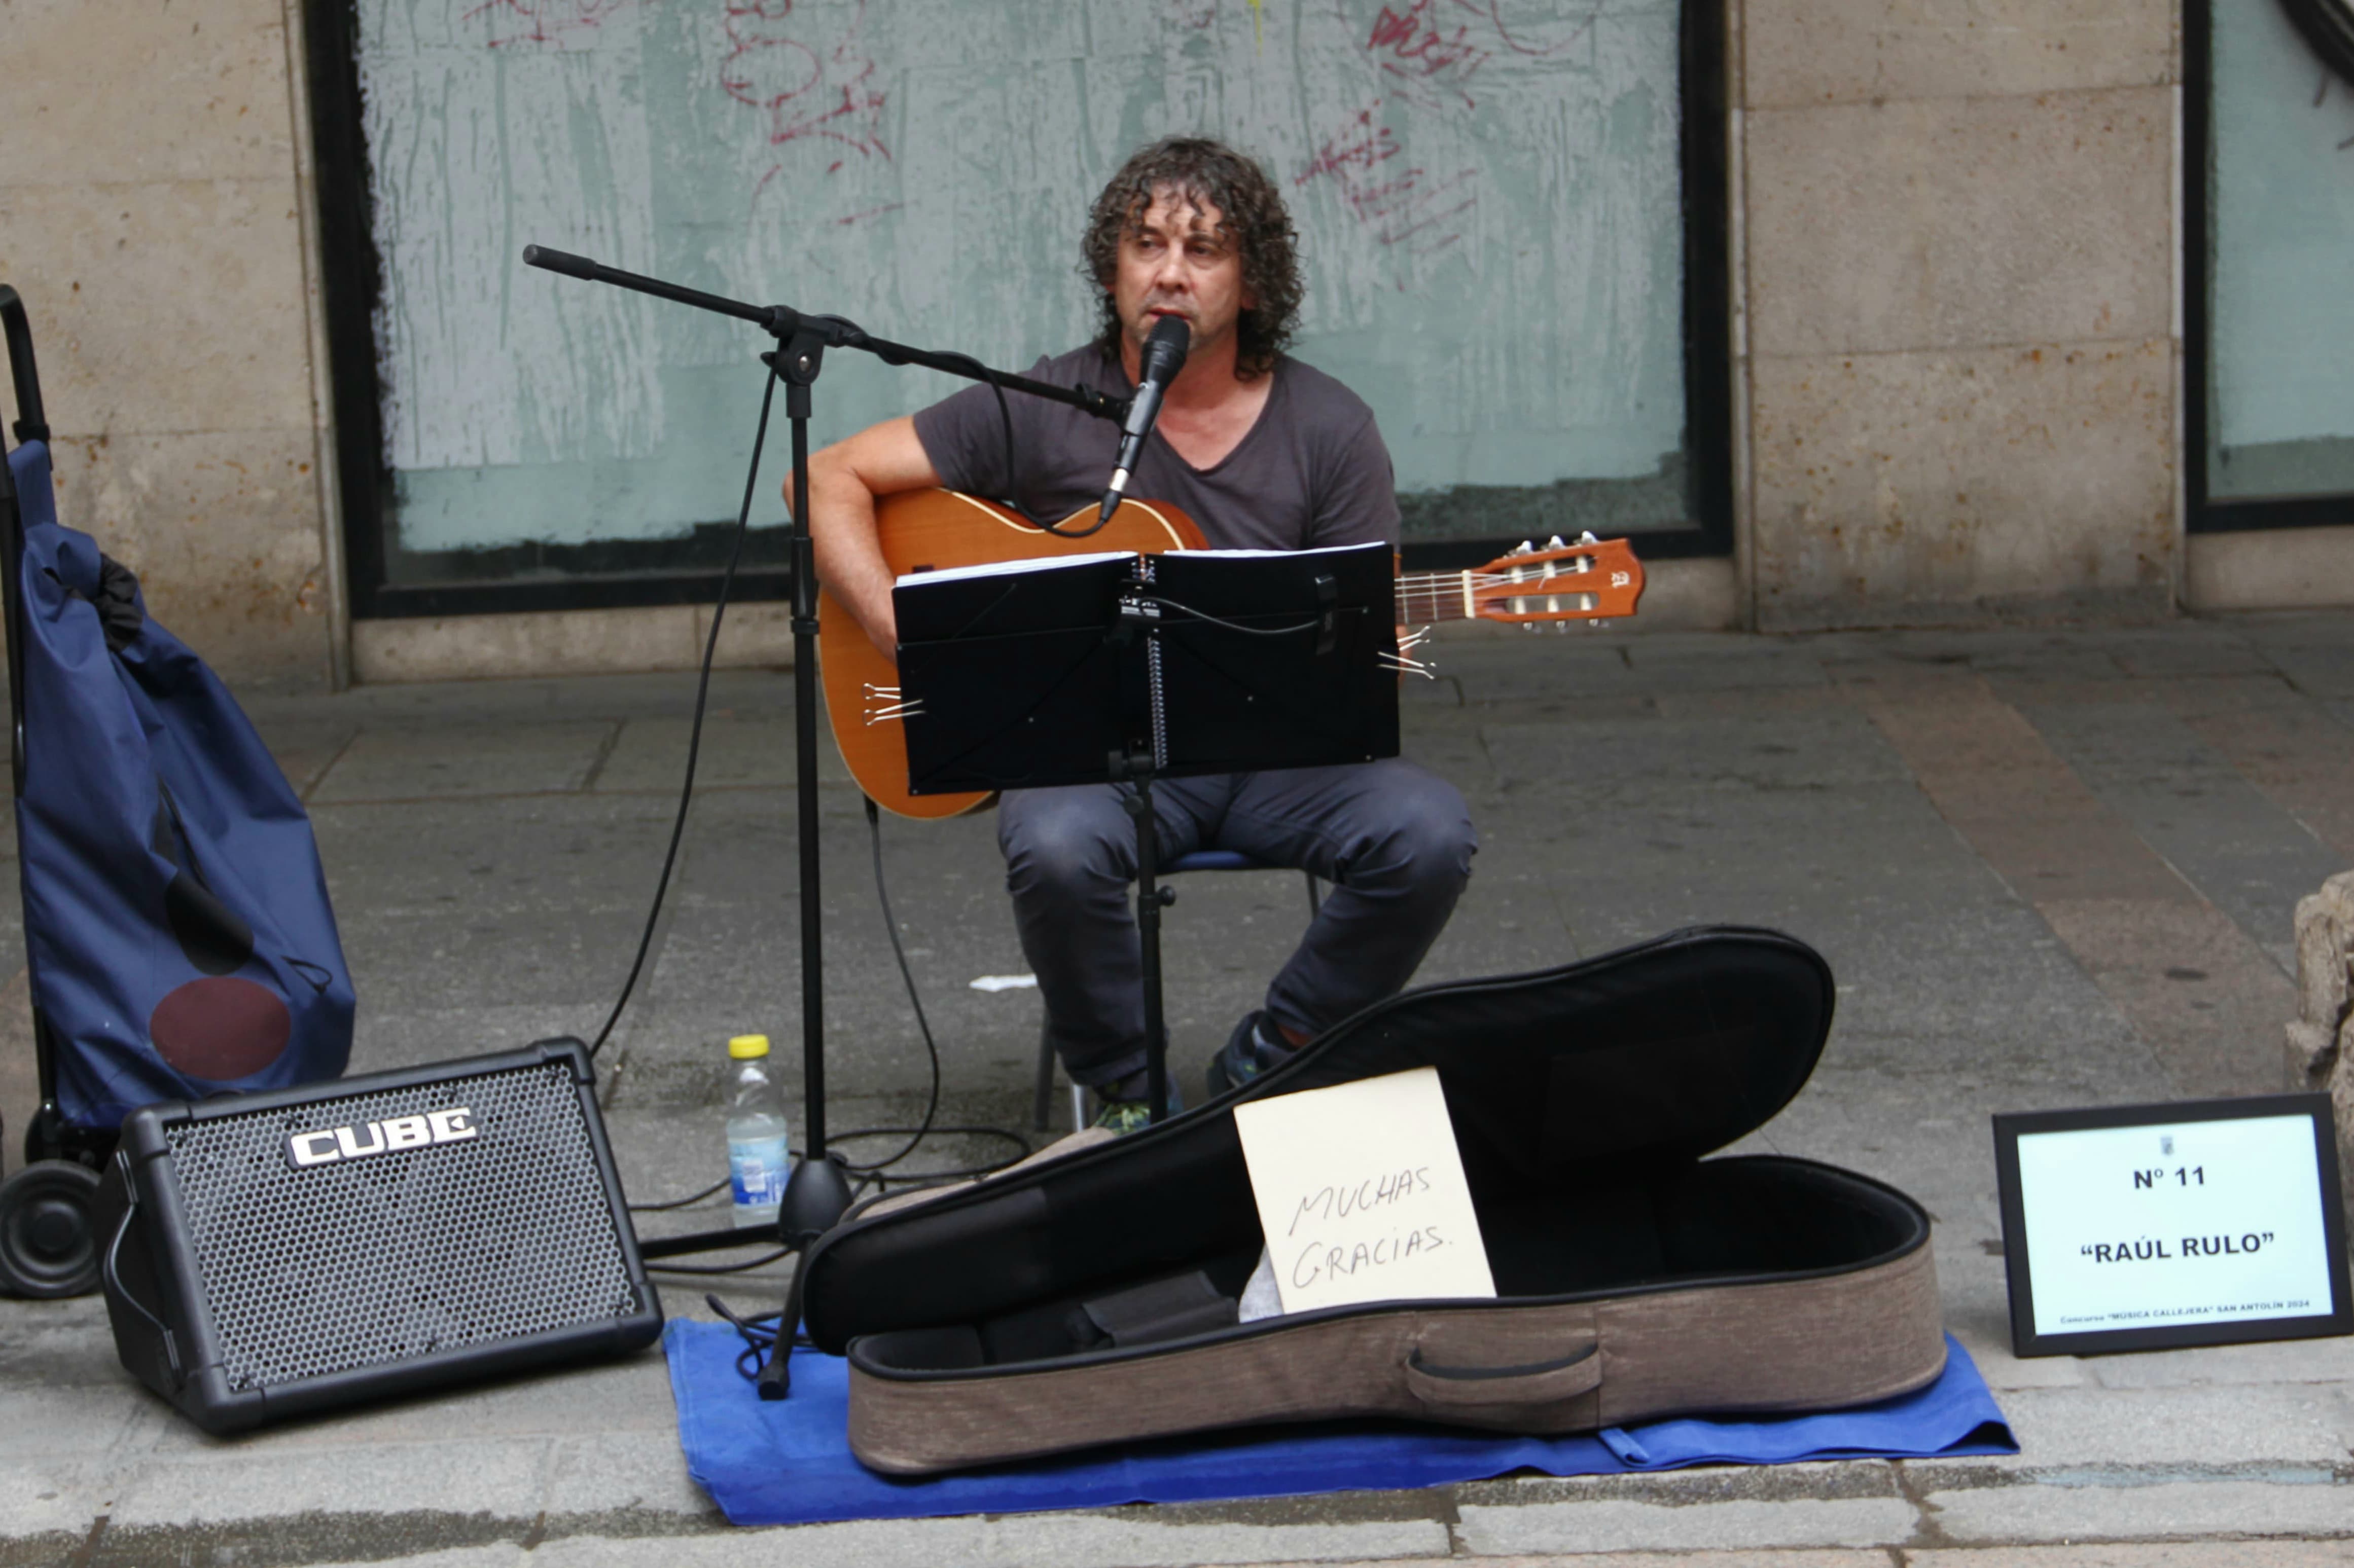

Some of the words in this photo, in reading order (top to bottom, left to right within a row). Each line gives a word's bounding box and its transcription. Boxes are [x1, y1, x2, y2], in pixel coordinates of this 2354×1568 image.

[291, 1107, 477, 1165] CUBE
[2175, 1166, 2205, 1186] 11
[1289, 1167, 1430, 1236] MUCHAS
[2217, 1304, 2237, 1314] SAN
[2287, 1299, 2310, 1308] 2024
